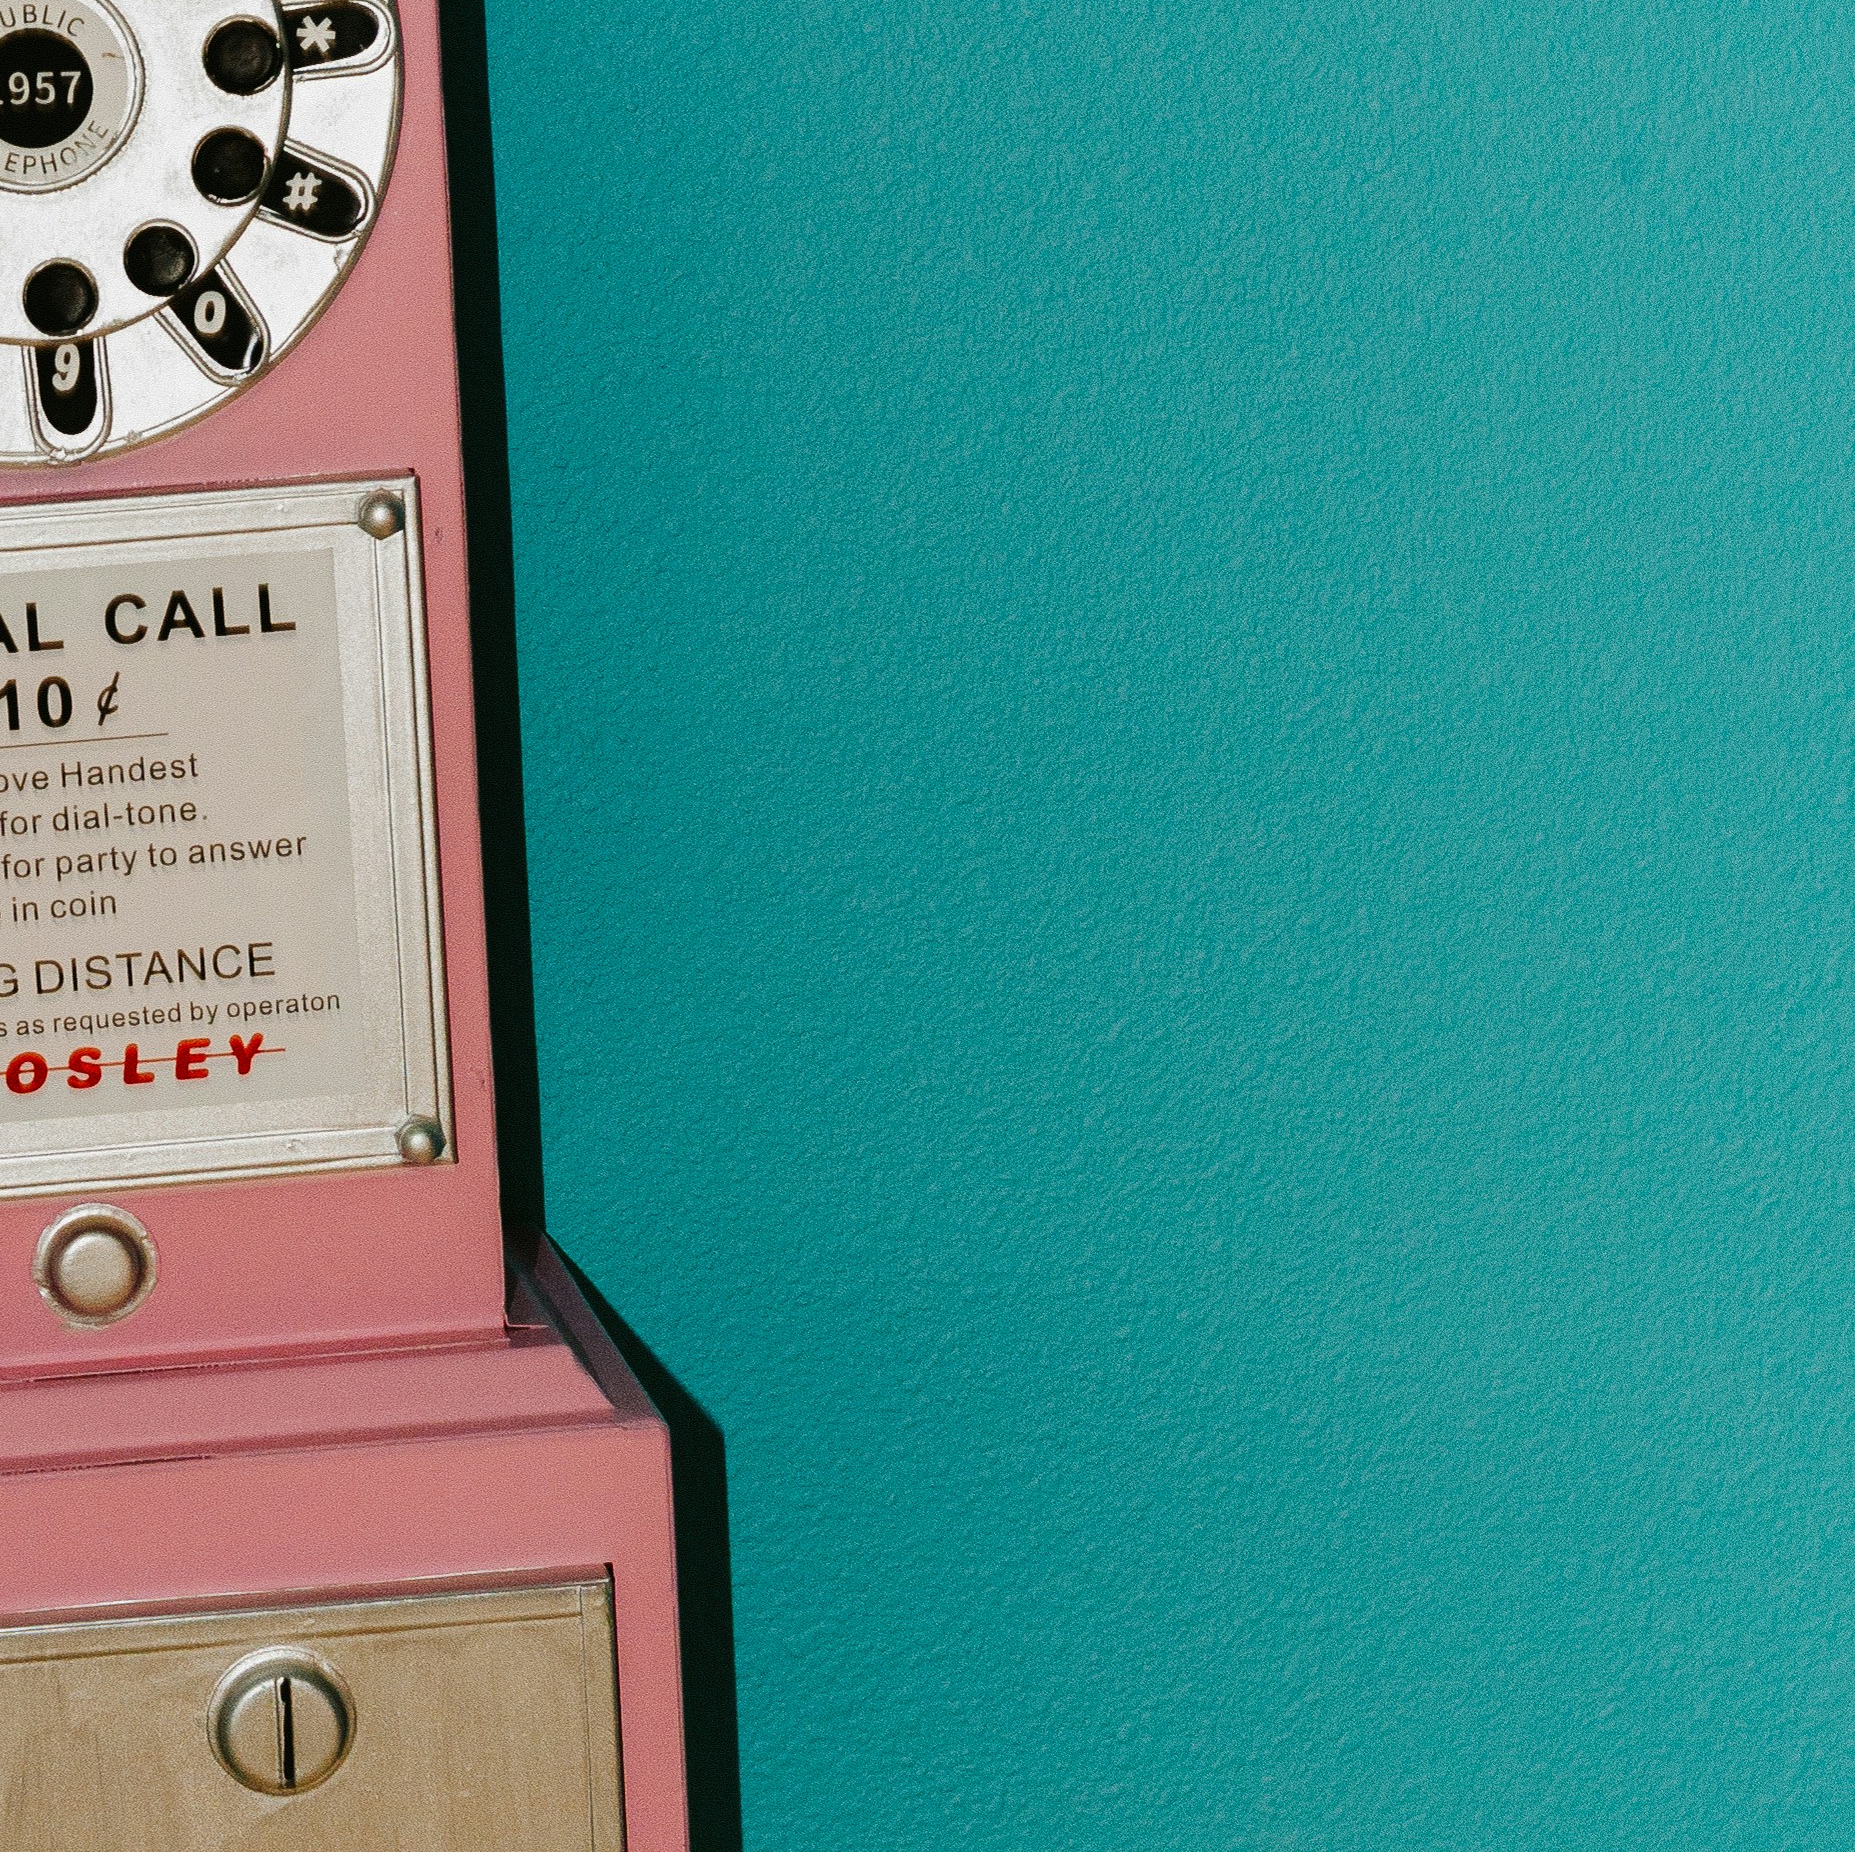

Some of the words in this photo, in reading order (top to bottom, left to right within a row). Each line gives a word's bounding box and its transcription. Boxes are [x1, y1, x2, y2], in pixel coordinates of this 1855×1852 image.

[50, 344, 81, 391] 9
[104, 583, 296, 645] CALL
[60, 754, 199, 788] Handest
[52, 800, 208, 833] dial-tone.
[1, 852, 45, 880] for
[55, 843, 137, 883] party
[147, 842, 178, 868] to
[188, 834, 306, 865] answer
[12, 898, 39, 924] in
[49, 892, 117, 920] coin
[34, 942, 275, 995] DISTANCE
[16, 1018, 45, 1037] as
[52, 1003, 181, 1037] requested
[189, 999, 219, 1026] by
[227, 993, 341, 1023] operaton
